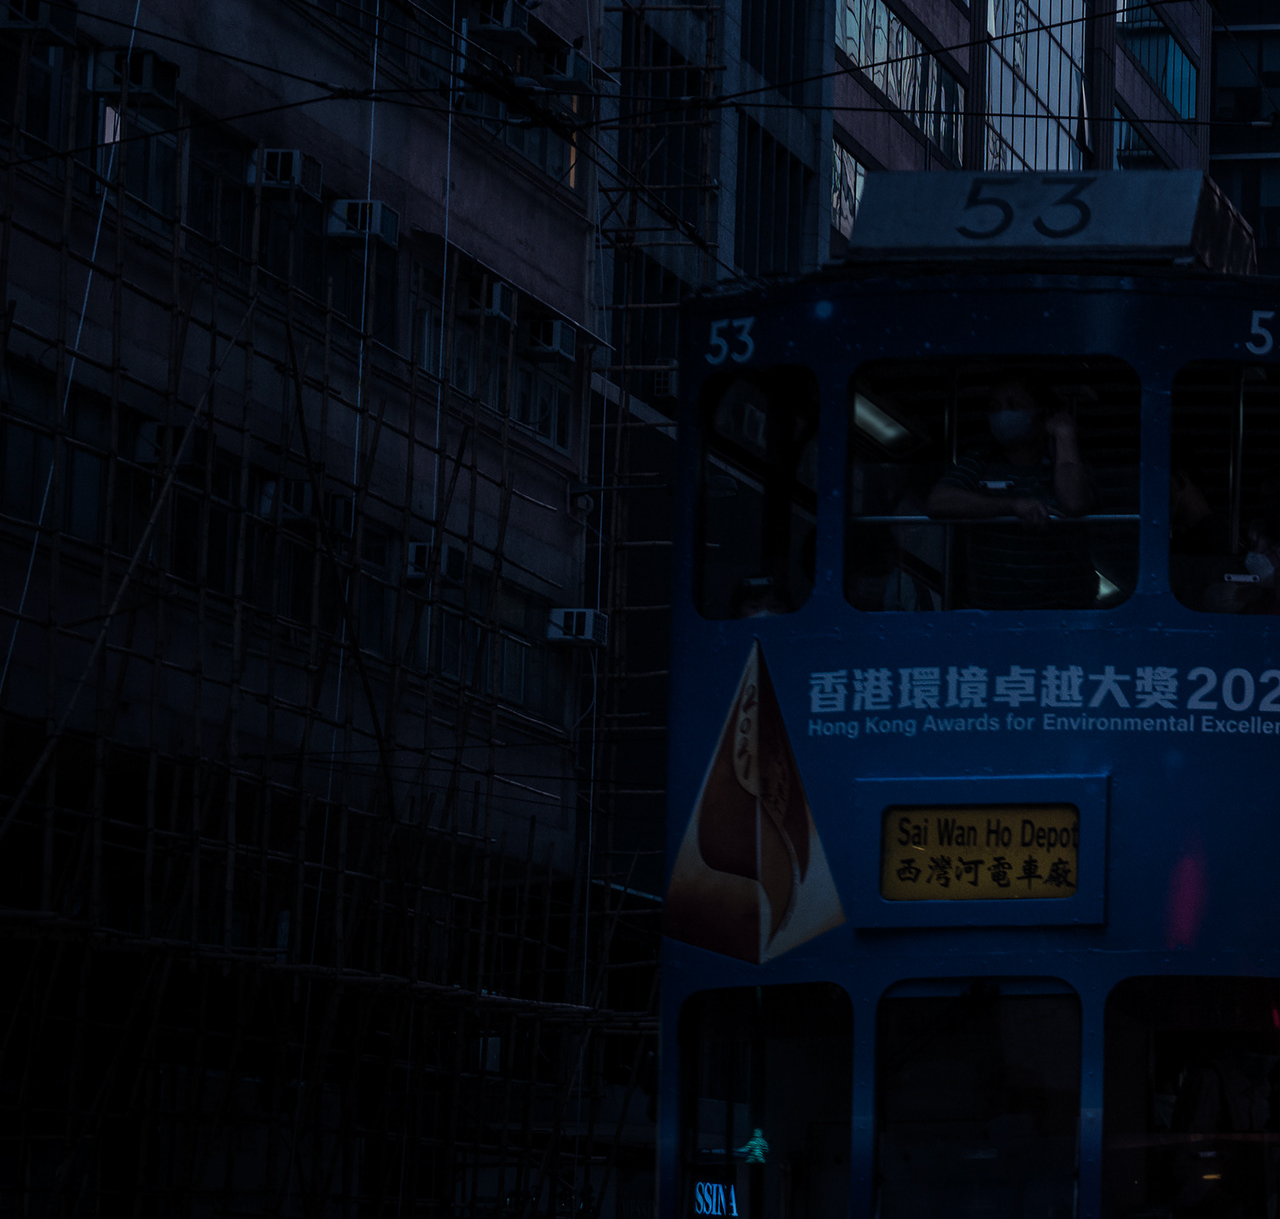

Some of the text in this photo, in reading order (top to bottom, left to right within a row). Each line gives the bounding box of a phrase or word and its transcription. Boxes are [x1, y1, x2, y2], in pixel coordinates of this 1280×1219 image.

[955, 177, 1098, 240] 53
[704, 316, 756, 367] 53
[808, 718, 860, 739] Hong
[865, 716, 918, 737] Kong
[922, 714, 1001, 733] Awards
[1005, 711, 1036, 731] for
[1042, 712, 1195, 733] Environmental
[898, 817, 1079, 854] Sai Wan Ho Depot
[896, 855, 1077, 889] 西灣河電車廠
